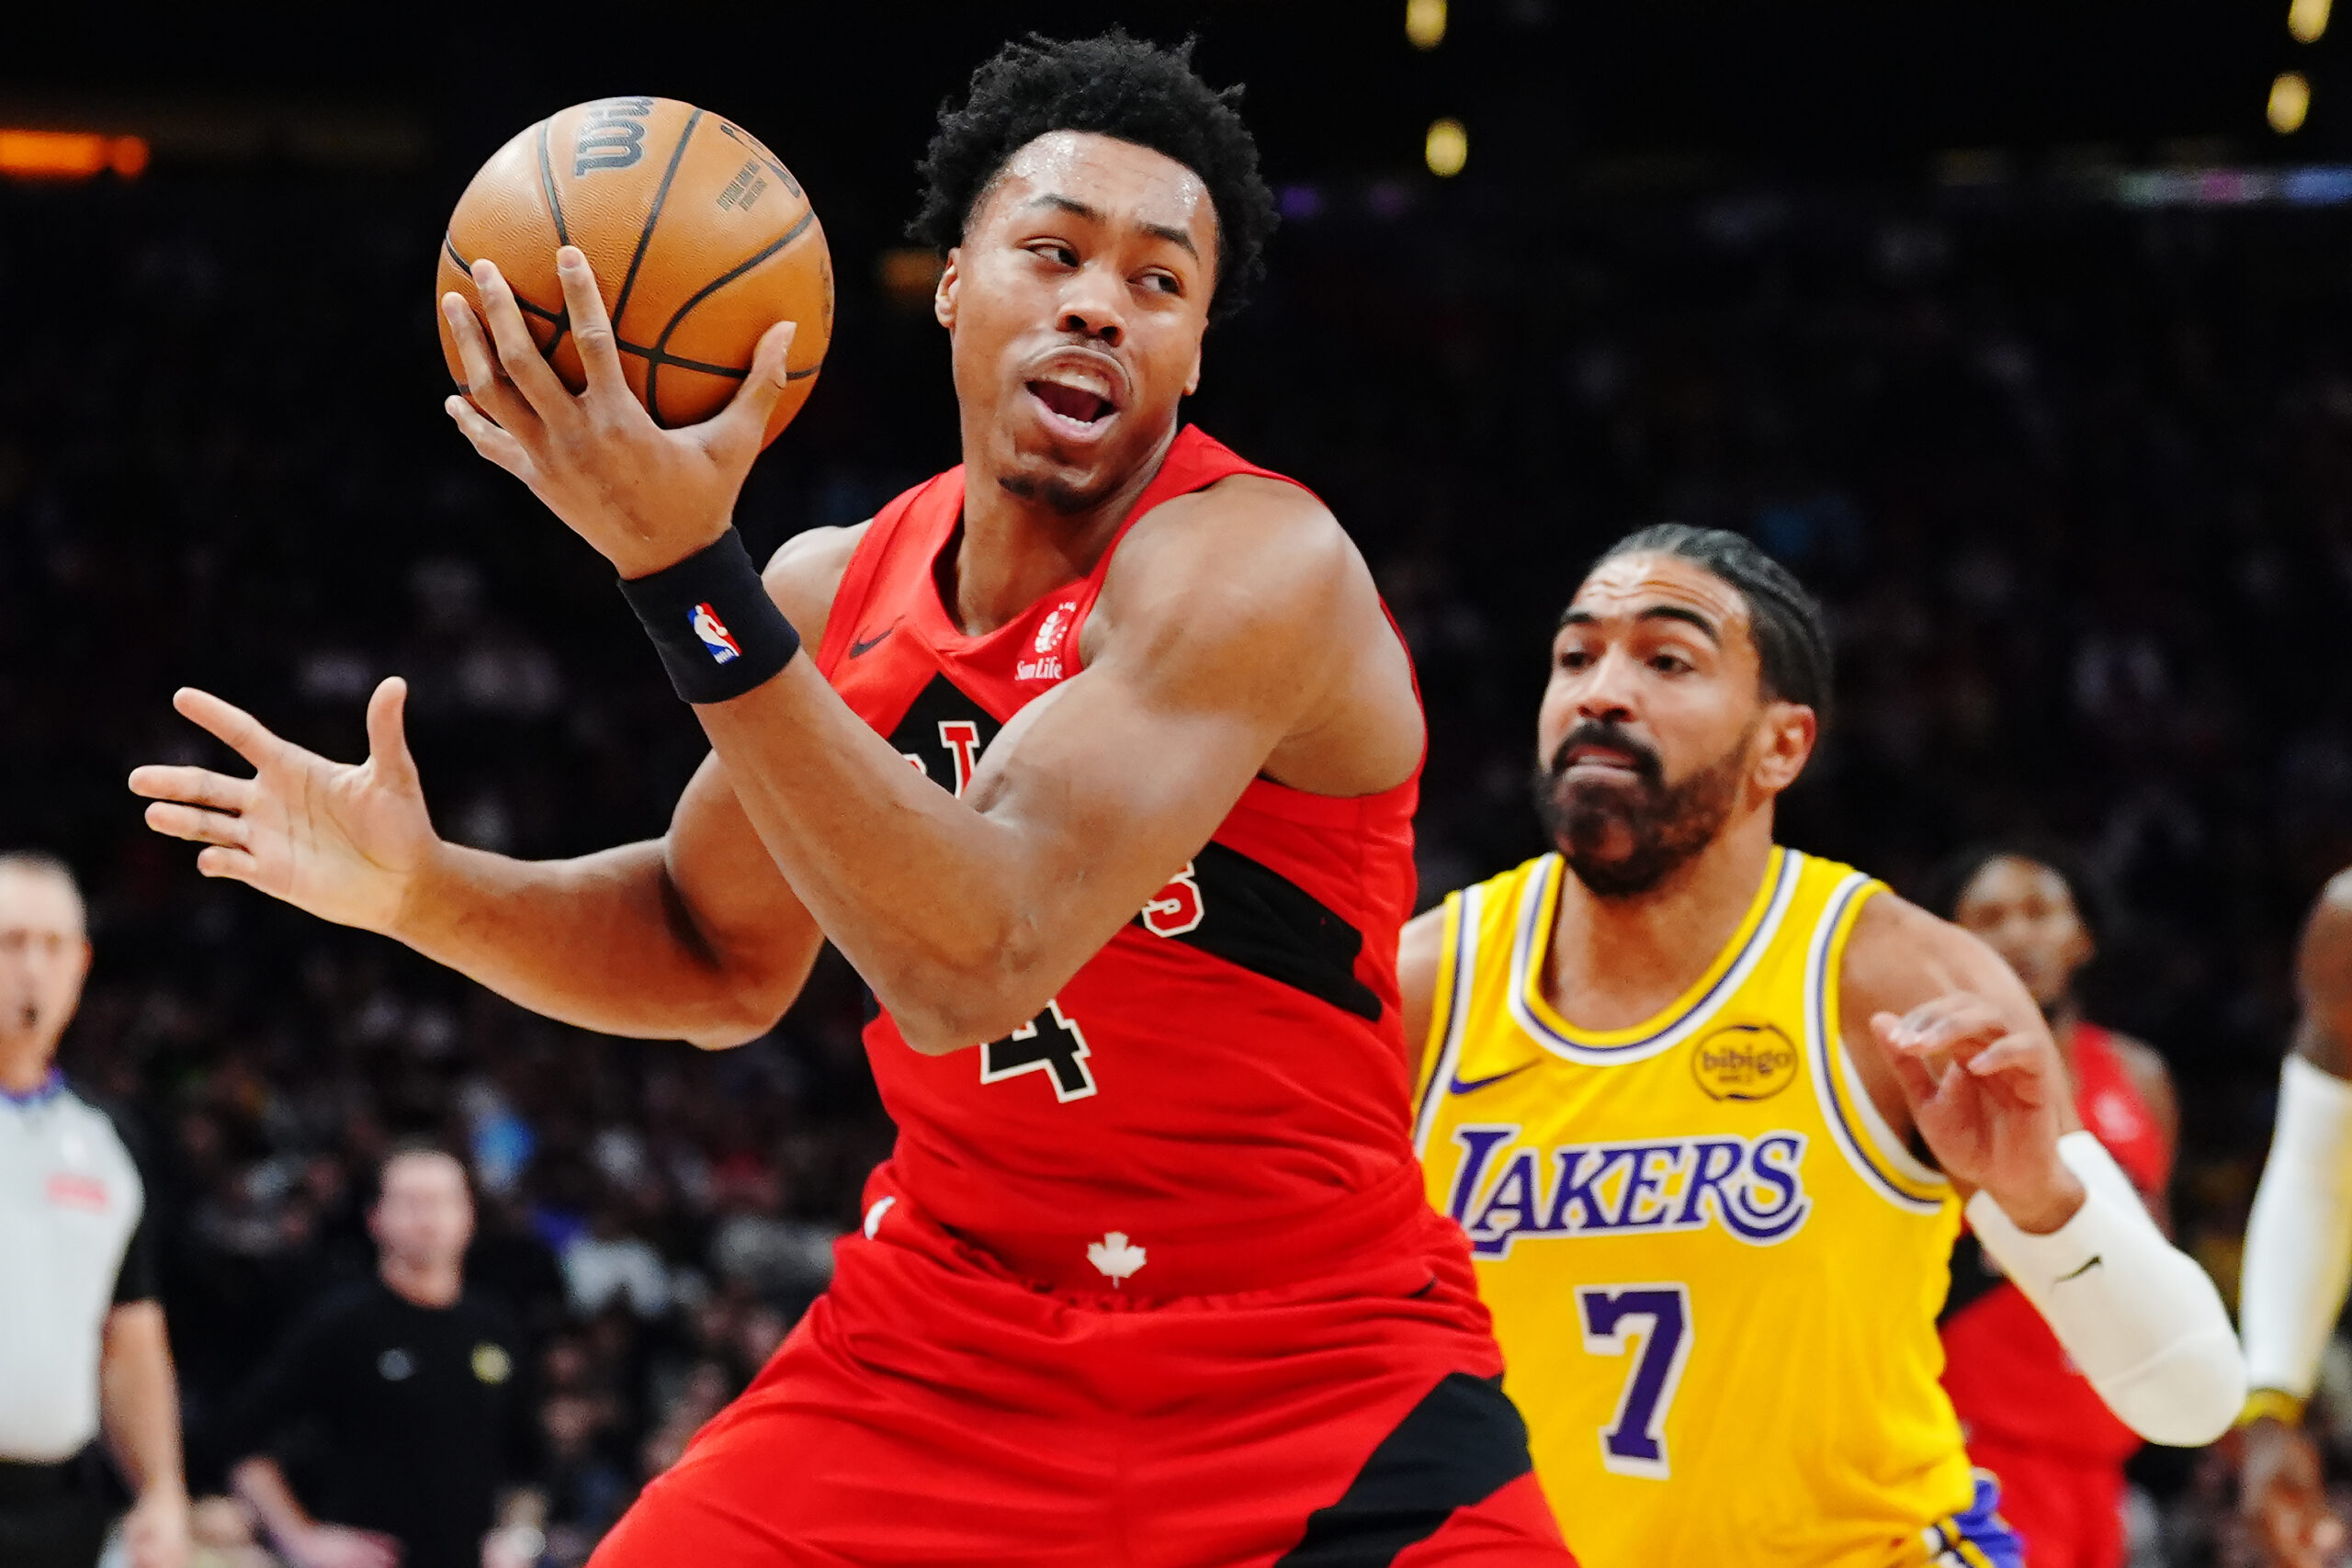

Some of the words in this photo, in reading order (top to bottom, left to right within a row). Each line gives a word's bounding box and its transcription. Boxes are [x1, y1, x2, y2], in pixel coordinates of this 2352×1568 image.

[1035, 656, 1063, 680] Life
[979, 998, 1098, 1104] 4
[1702, 1044, 1792, 1077] bibigo
[1448, 1123, 1813, 1261] LAKERS
[1576, 1282, 1694, 1480] 7
